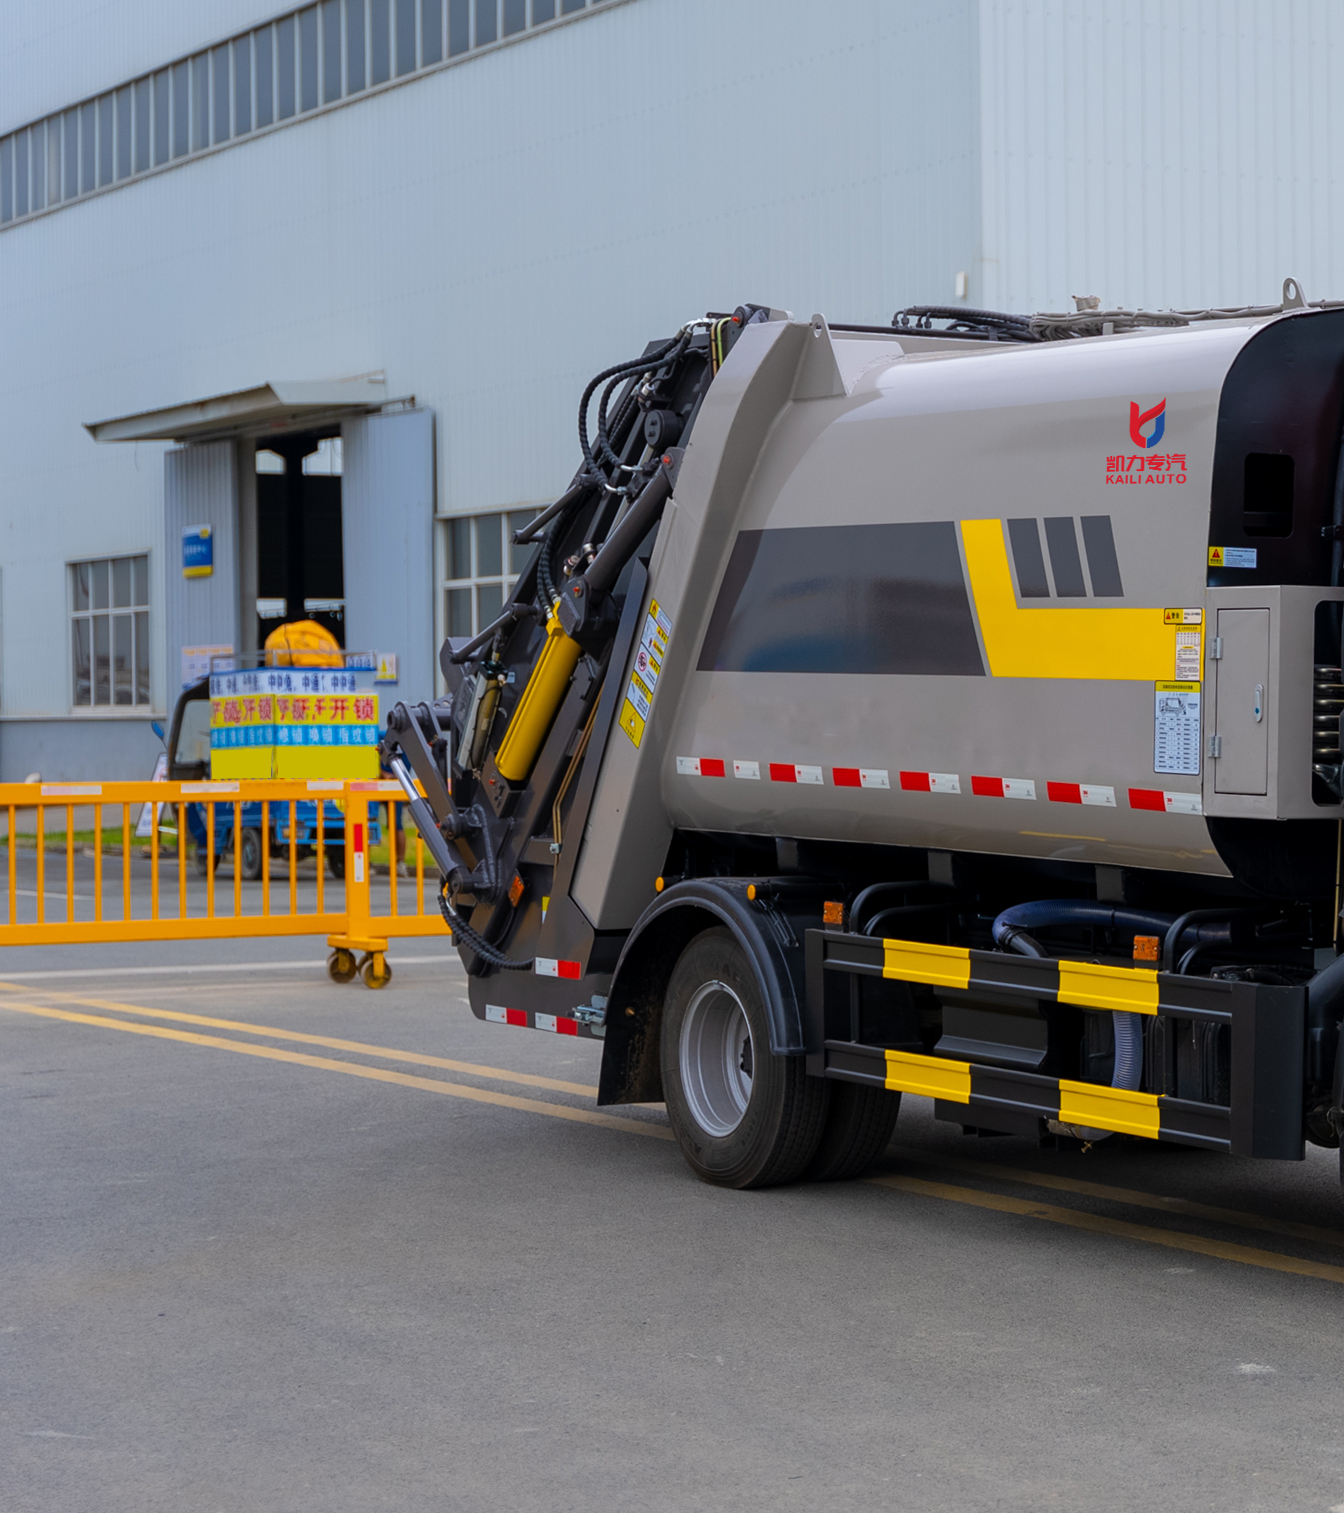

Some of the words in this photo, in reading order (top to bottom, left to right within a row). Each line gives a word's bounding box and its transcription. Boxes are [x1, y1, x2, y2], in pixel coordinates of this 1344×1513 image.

[1106, 453, 1187, 472] 凯力专汽
[1106, 474, 1141, 485] KAILI
[1145, 473, 1187, 485] AUTO
